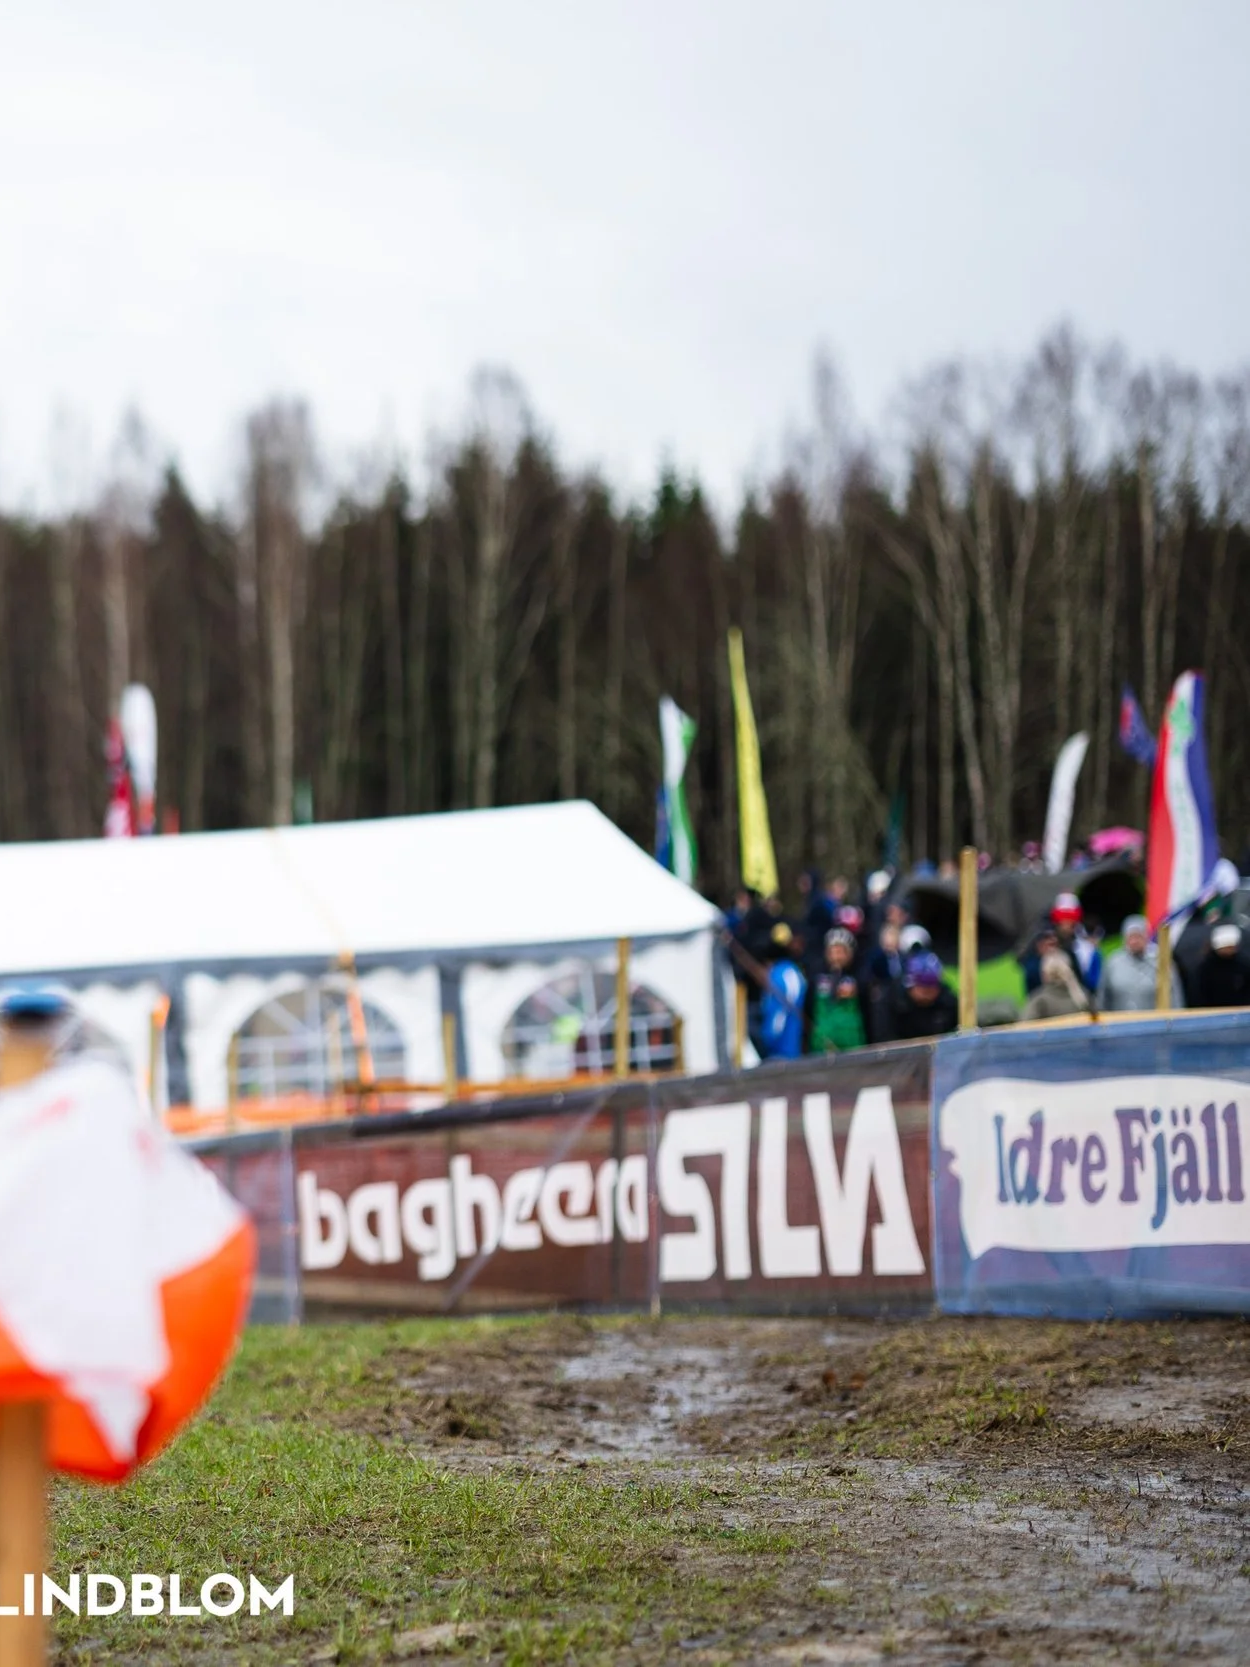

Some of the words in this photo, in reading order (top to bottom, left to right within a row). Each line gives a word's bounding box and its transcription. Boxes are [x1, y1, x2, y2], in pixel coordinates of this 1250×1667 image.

[297, 1154, 650, 1282] bagheera
[657, 1085, 926, 1282] SILVA
[993, 1109, 1108, 1205] Idre
[1113, 1101, 1246, 1231] Fjäll
